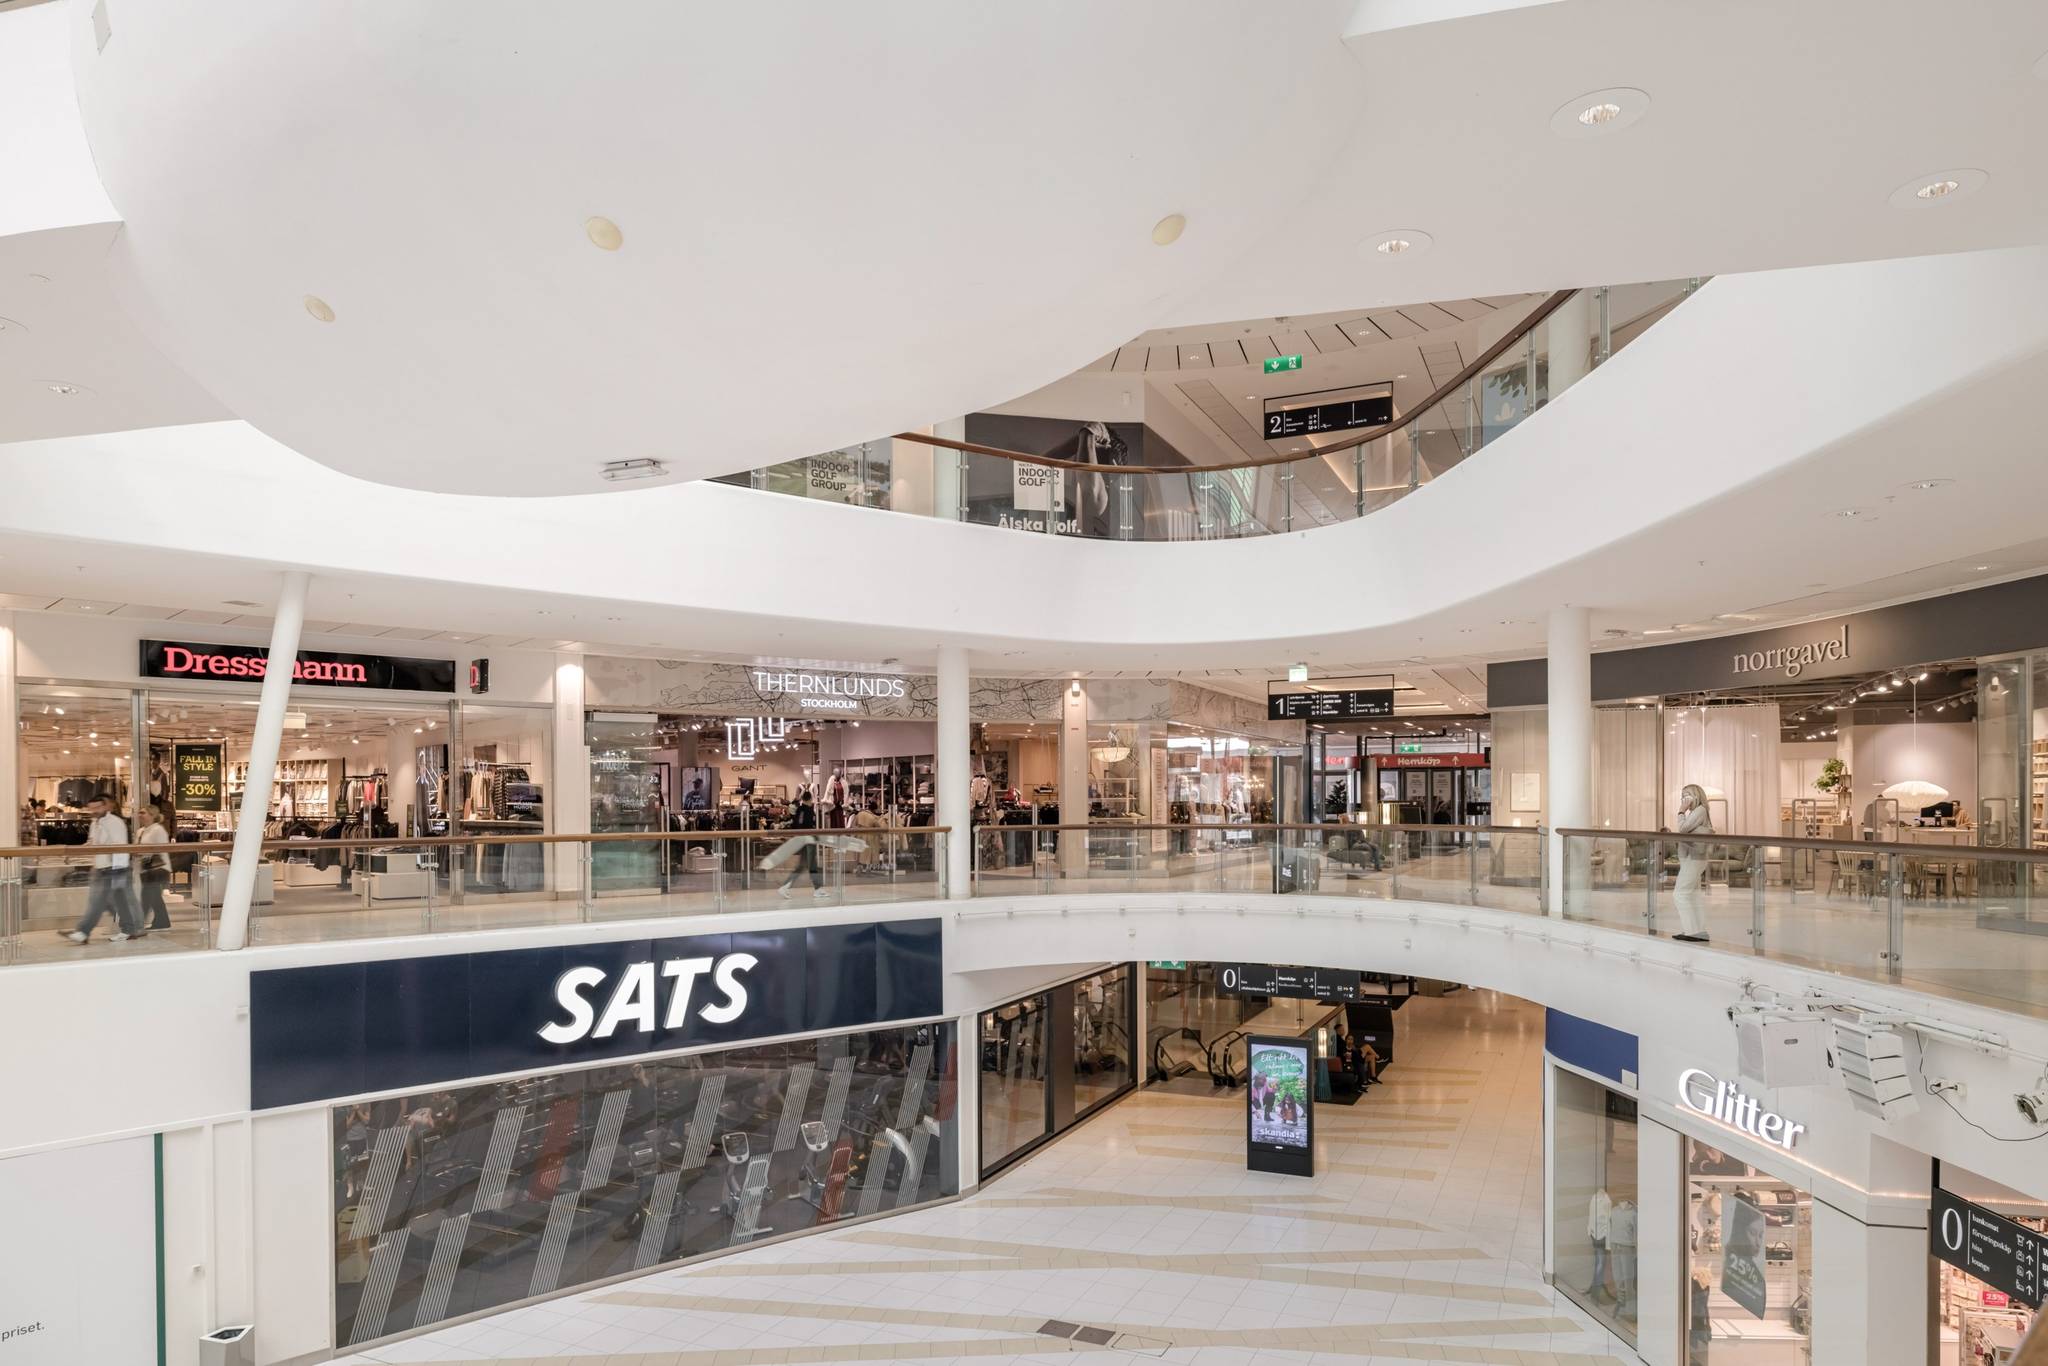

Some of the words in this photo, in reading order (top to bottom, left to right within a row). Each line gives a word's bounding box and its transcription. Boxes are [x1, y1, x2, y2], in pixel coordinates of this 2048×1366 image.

[1270, 416, 1282, 433] 2
[811, 459, 850, 473] INDOOR
[811, 469, 837, 480] GOLF
[811, 478, 847, 492] GROUP
[1018, 477, 1046, 487] GOLF
[998, 513, 1044, 532] Älska
[1048, 519, 1082, 533] olf.
[1732, 624, 1849, 677] norrgavel
[753, 671, 905, 698] THERNLUNDS
[801, 698, 857, 709] STOCKHOLM
[1276, 698, 1284, 715] 1
[180, 755, 203, 763] FALL
[205, 755, 217, 763] IN
[183, 763, 214, 771] STYLE
[1397, 756, 1441, 766] Hemköp
[731, 764, 768, 772] GANT
[180, 784, 216, 796] -30%
[1223, 968, 1236, 988] 0
[537, 952, 759, 1044] SATS
[1678, 1068, 1804, 1150] Glitter
[1942, 1208, 1963, 1251] 0
[1972, 1214, 1999, 1233] bankomat
[1729, 1253, 1757, 1283] 25%
[1986, 1293, 2006, 1302] 25%
[2, 1321, 45, 1342] priset.
